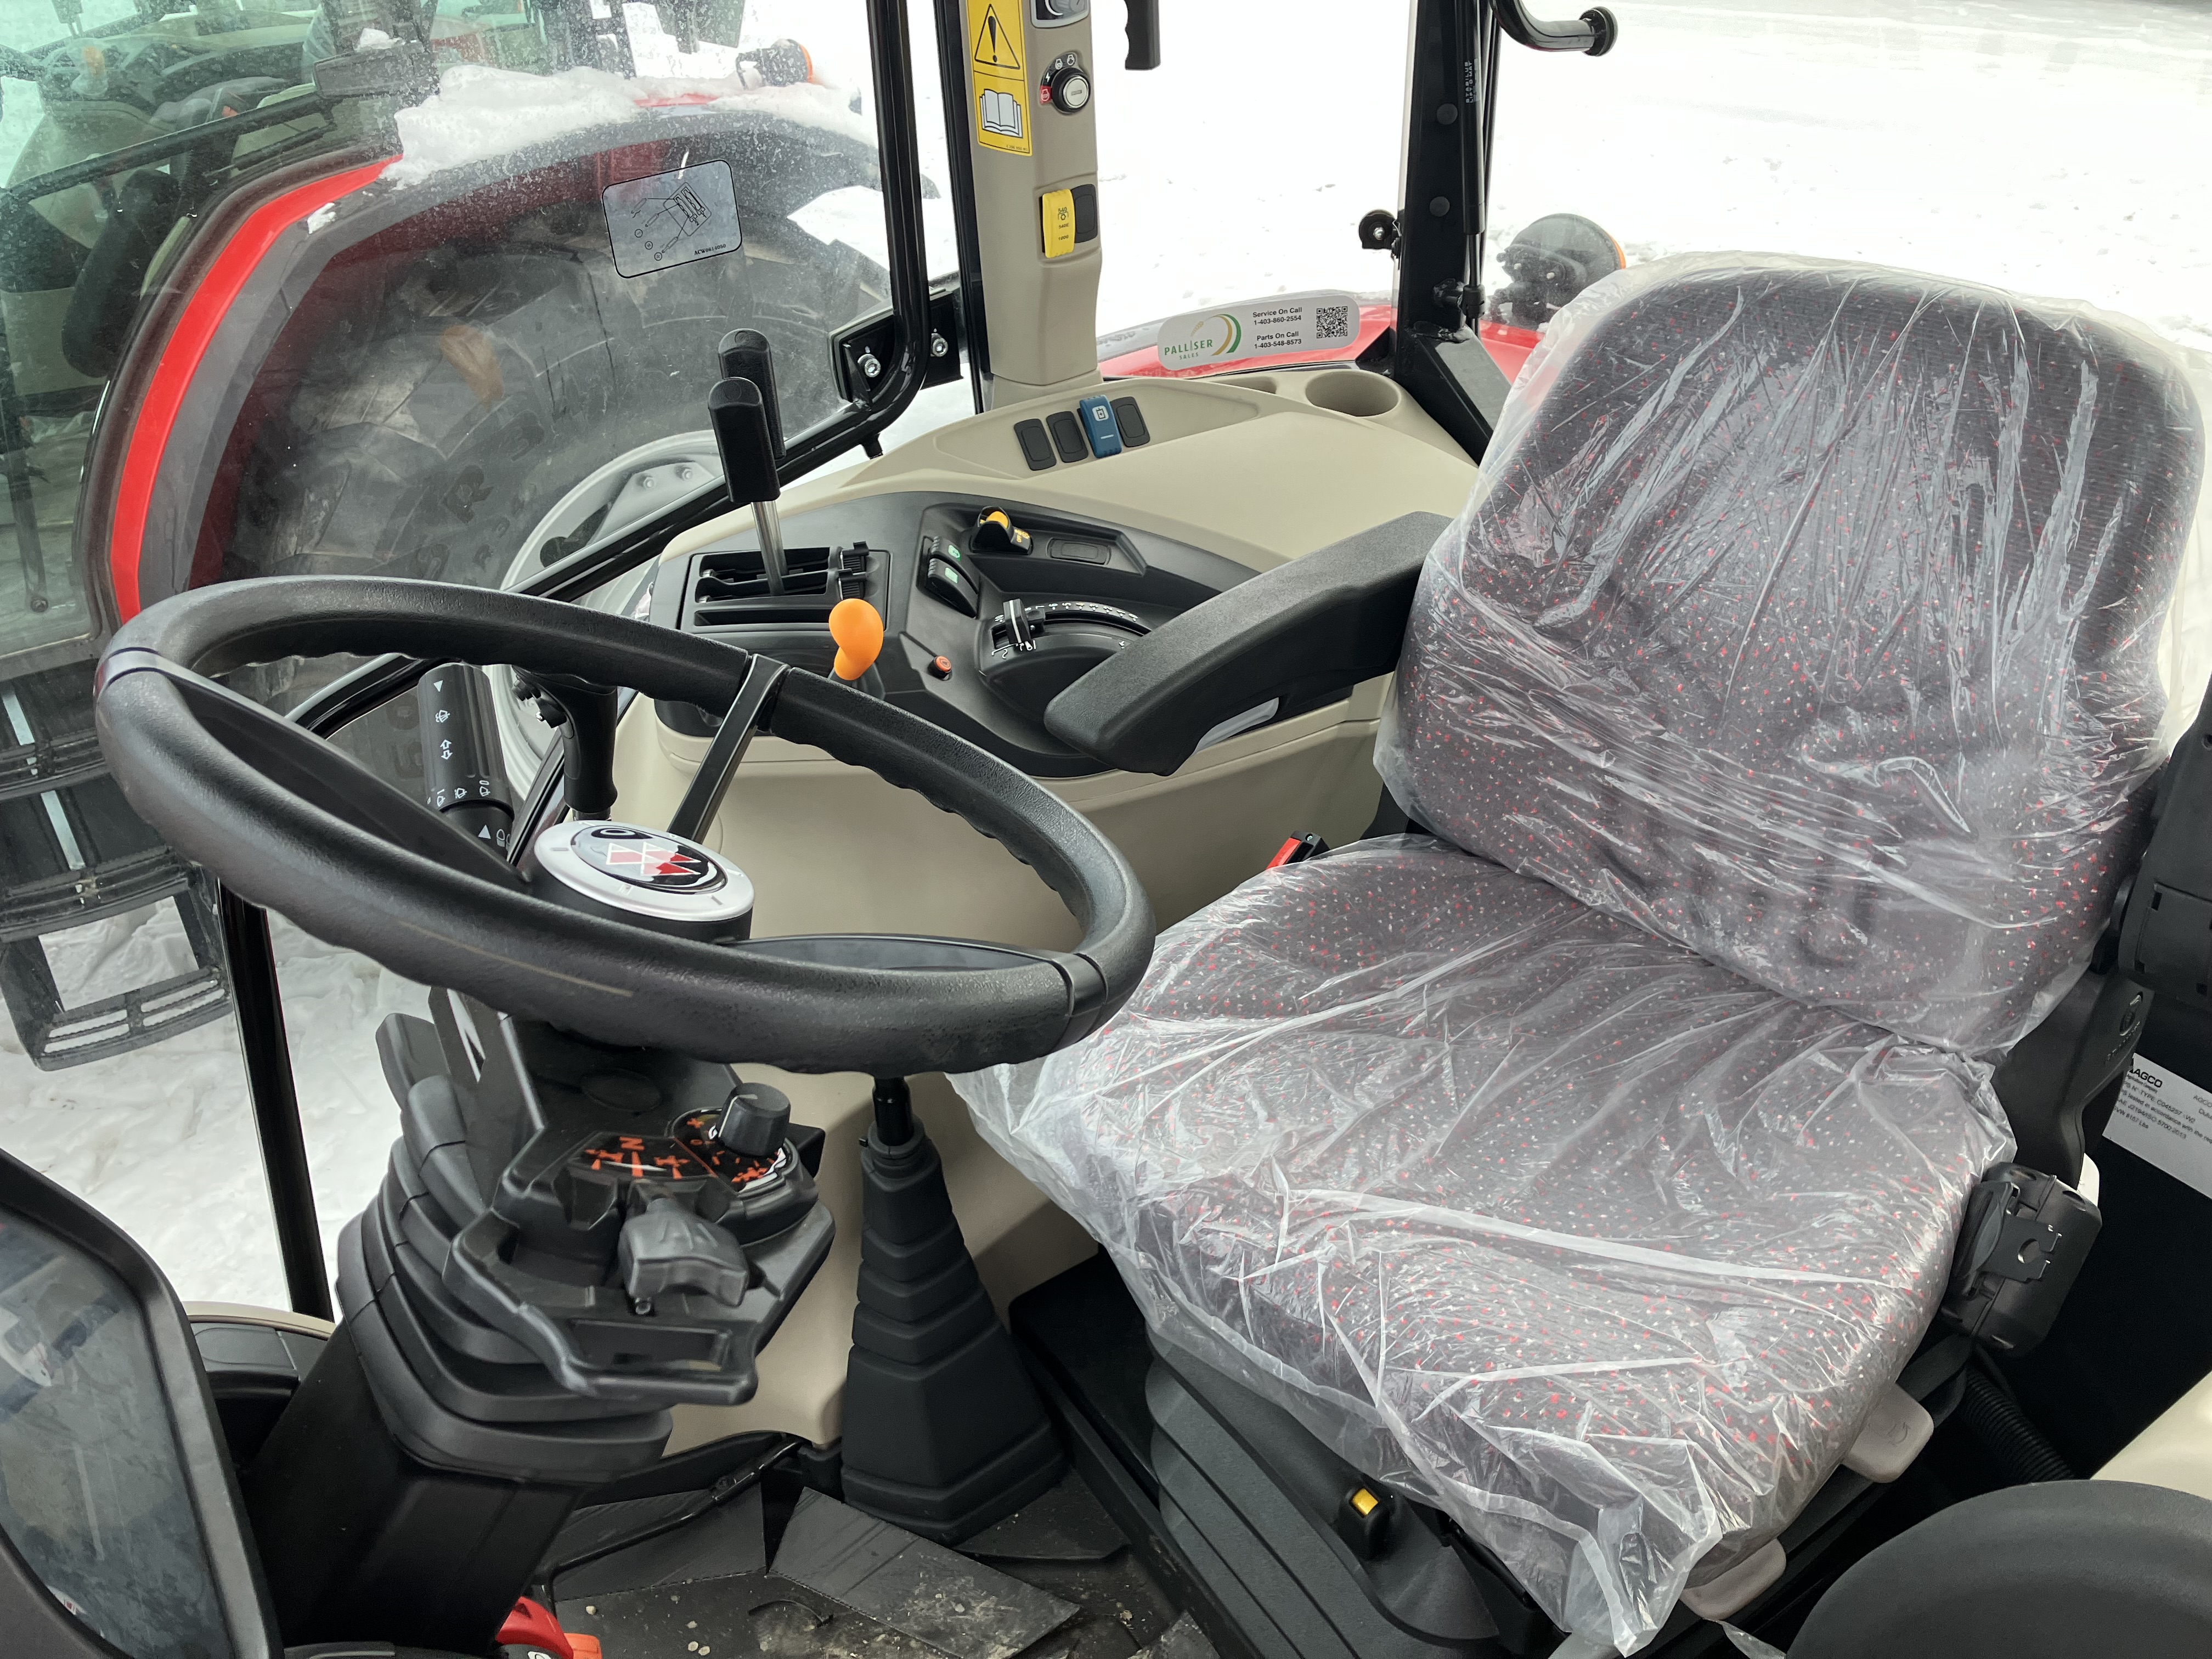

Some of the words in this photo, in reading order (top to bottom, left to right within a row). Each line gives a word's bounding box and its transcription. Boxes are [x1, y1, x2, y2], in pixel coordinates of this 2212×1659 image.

[1164, 339, 1213, 356] PALLISER
[1254, 338, 1302, 349] 1-403-548-8573
[1179, 352, 1199, 360] SALES
[2133, 1069, 2163, 1088] AGCO
[2151, 1107, 2181, 1126] accordance
[619, 1136, 645, 1151] N
